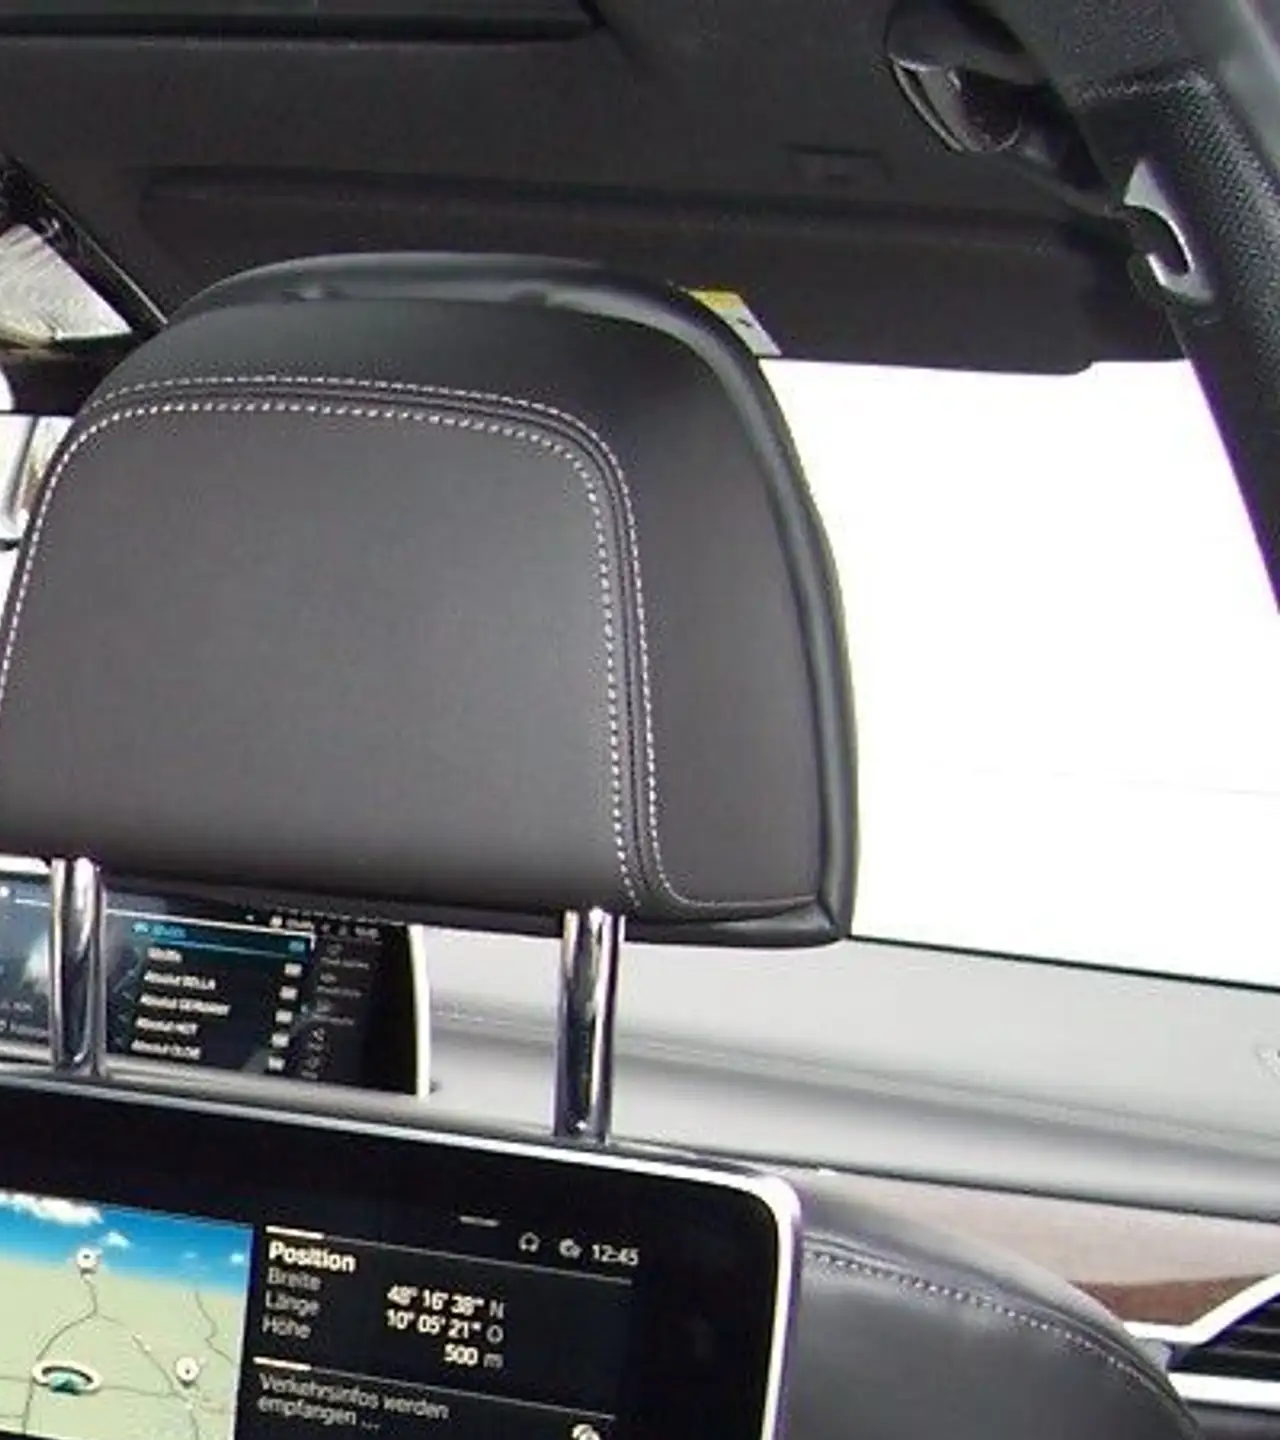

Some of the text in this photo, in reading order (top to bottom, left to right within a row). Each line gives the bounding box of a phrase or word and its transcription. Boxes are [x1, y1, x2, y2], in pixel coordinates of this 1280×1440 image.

[268, 1240, 356, 1274] Position
[590, 1242, 640, 1267] 12:45
[267, 1267, 322, 1291] Breite
[265, 1289, 320, 1317] Länge
[489, 1300, 505, 1319] N
[262, 1315, 311, 1340] Höhe
[443, 1342, 479, 1367] 500
[258, 1372, 450, 1421] Verkehrsinfos werden
[257, 1397, 358, 1427] empfangen
